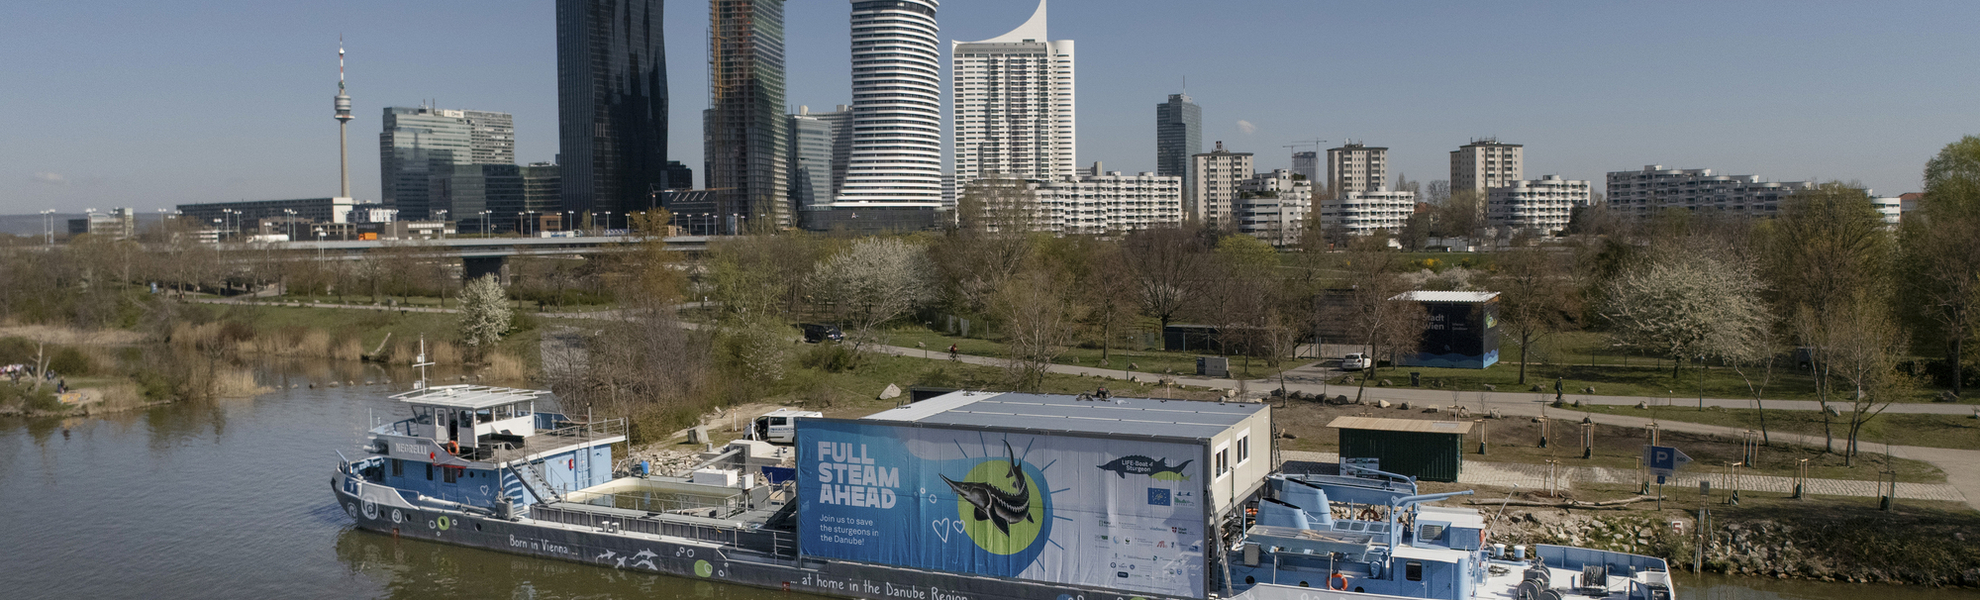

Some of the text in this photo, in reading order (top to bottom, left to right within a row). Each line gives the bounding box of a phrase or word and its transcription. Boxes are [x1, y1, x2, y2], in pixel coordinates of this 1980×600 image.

[395, 442, 427, 455] NEGRELLI
[818, 441, 874, 464] FULL
[1656, 451, 1669, 463] P
[818, 462, 899, 488] STEAM
[819, 484, 896, 509] AHEAD
[820, 514, 835, 522] Join
[820, 524, 879, 537] the sturgeons in
[509, 534, 527, 548] Born
[530, 538, 539, 550] in
[541, 539, 568, 554] Vienna
[820, 534, 865, 545] the Danube!
[802, 573, 812, 586] at
[816, 574, 845, 590] home
[849, 578, 859, 592] in
[863, 580, 881, 595] the
[886, 582, 925, 599] Danube
[931, 587, 968, 600] Region
